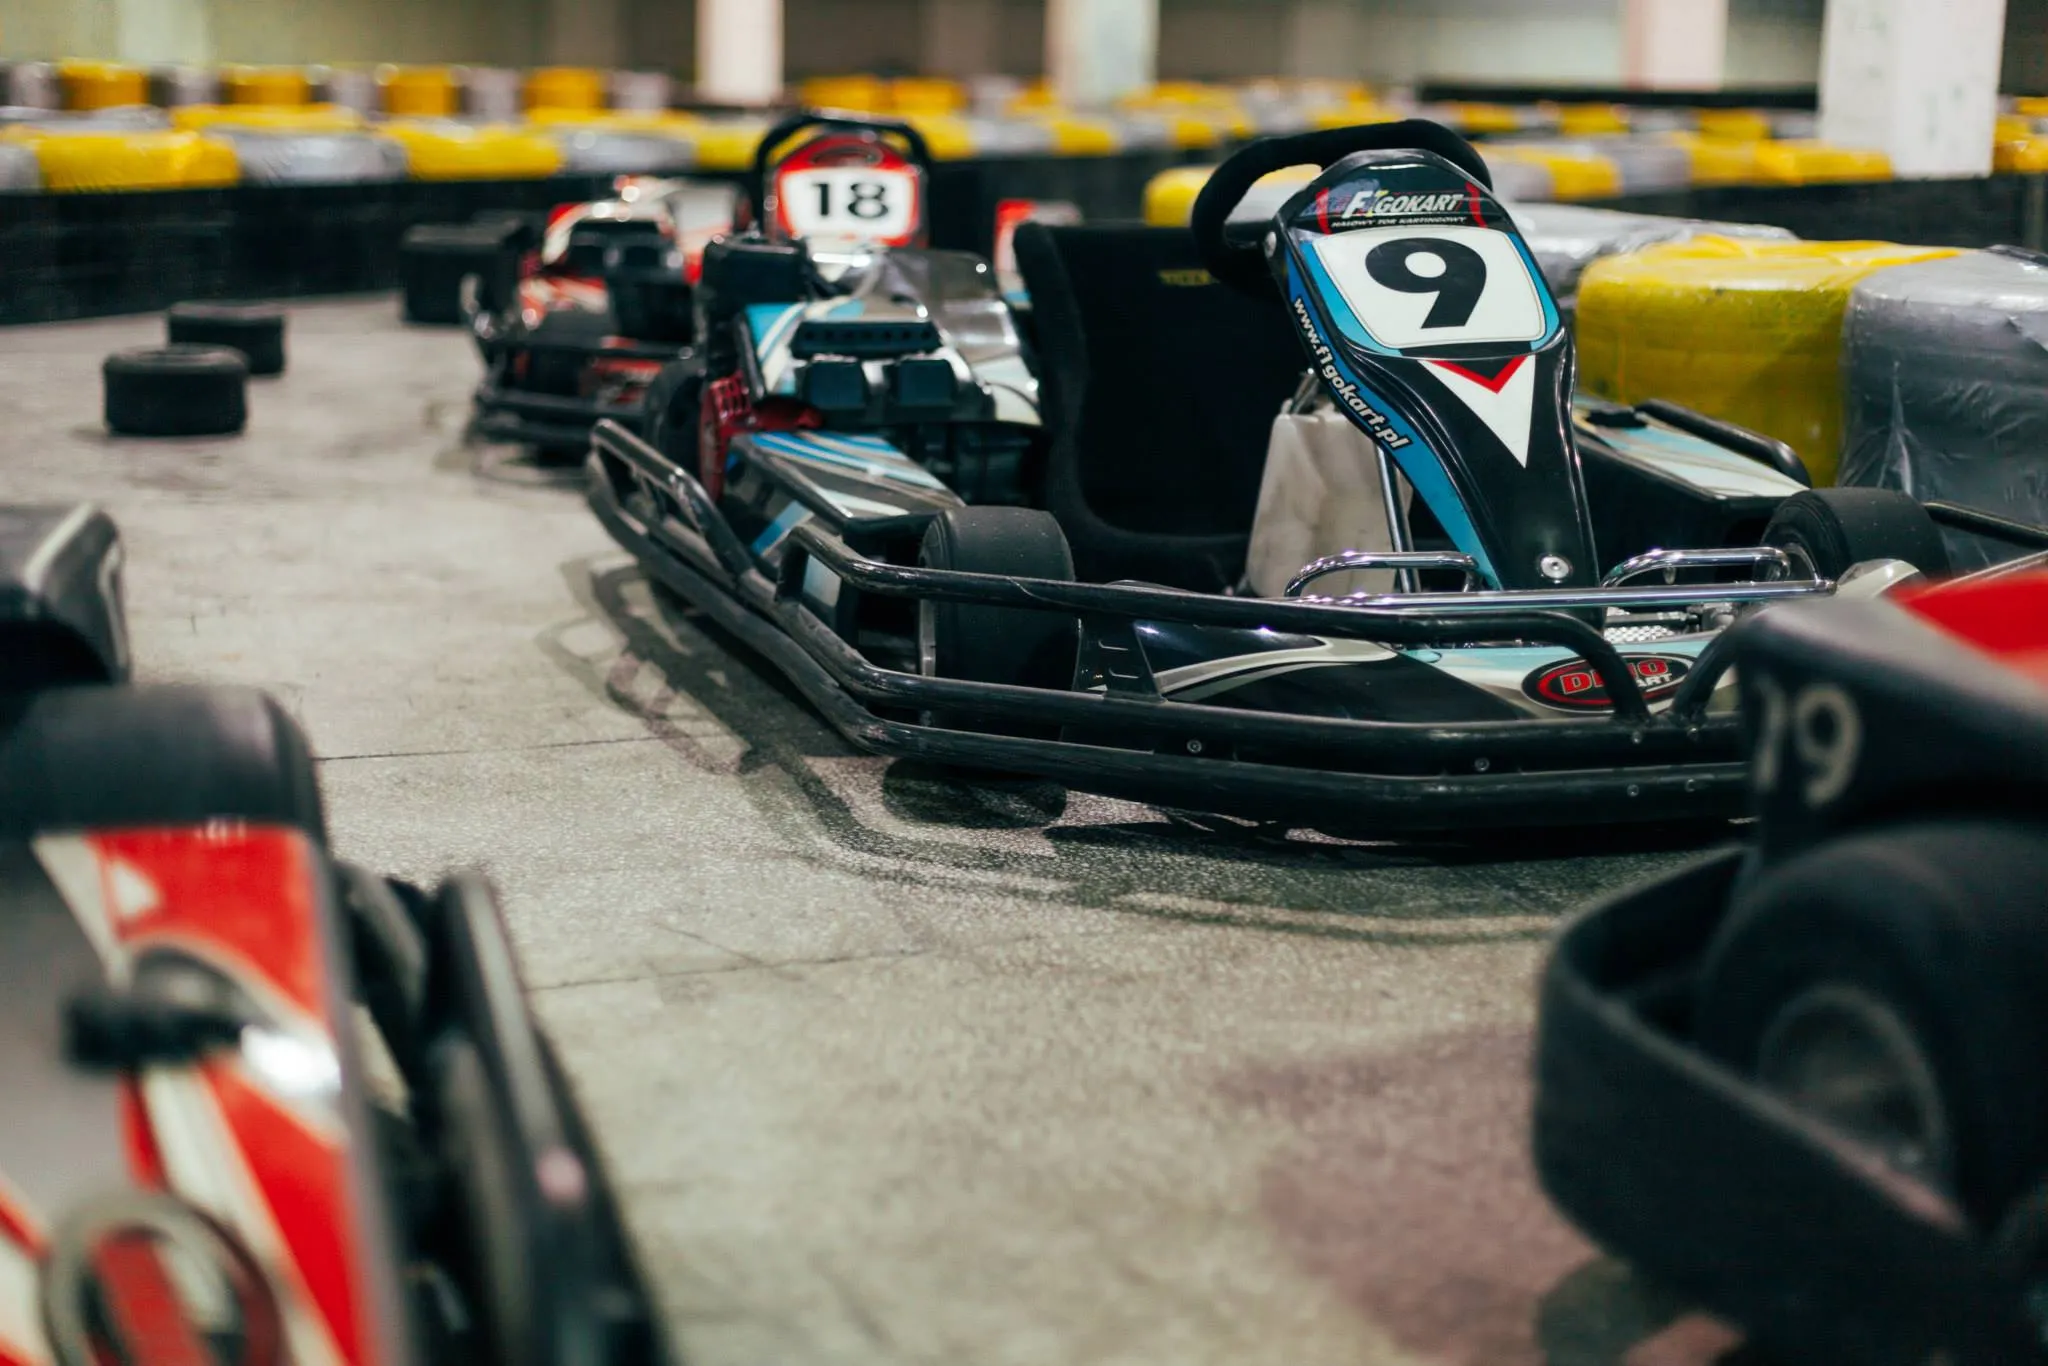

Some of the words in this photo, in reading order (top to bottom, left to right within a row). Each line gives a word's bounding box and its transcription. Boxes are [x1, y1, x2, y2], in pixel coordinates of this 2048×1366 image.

[811, 182, 889, 219] 18
[1365, 237, 1487, 329] 9
[1294, 297, 1411, 449] www.f1gokart.pl
[1635, 673, 1673, 688] ART
